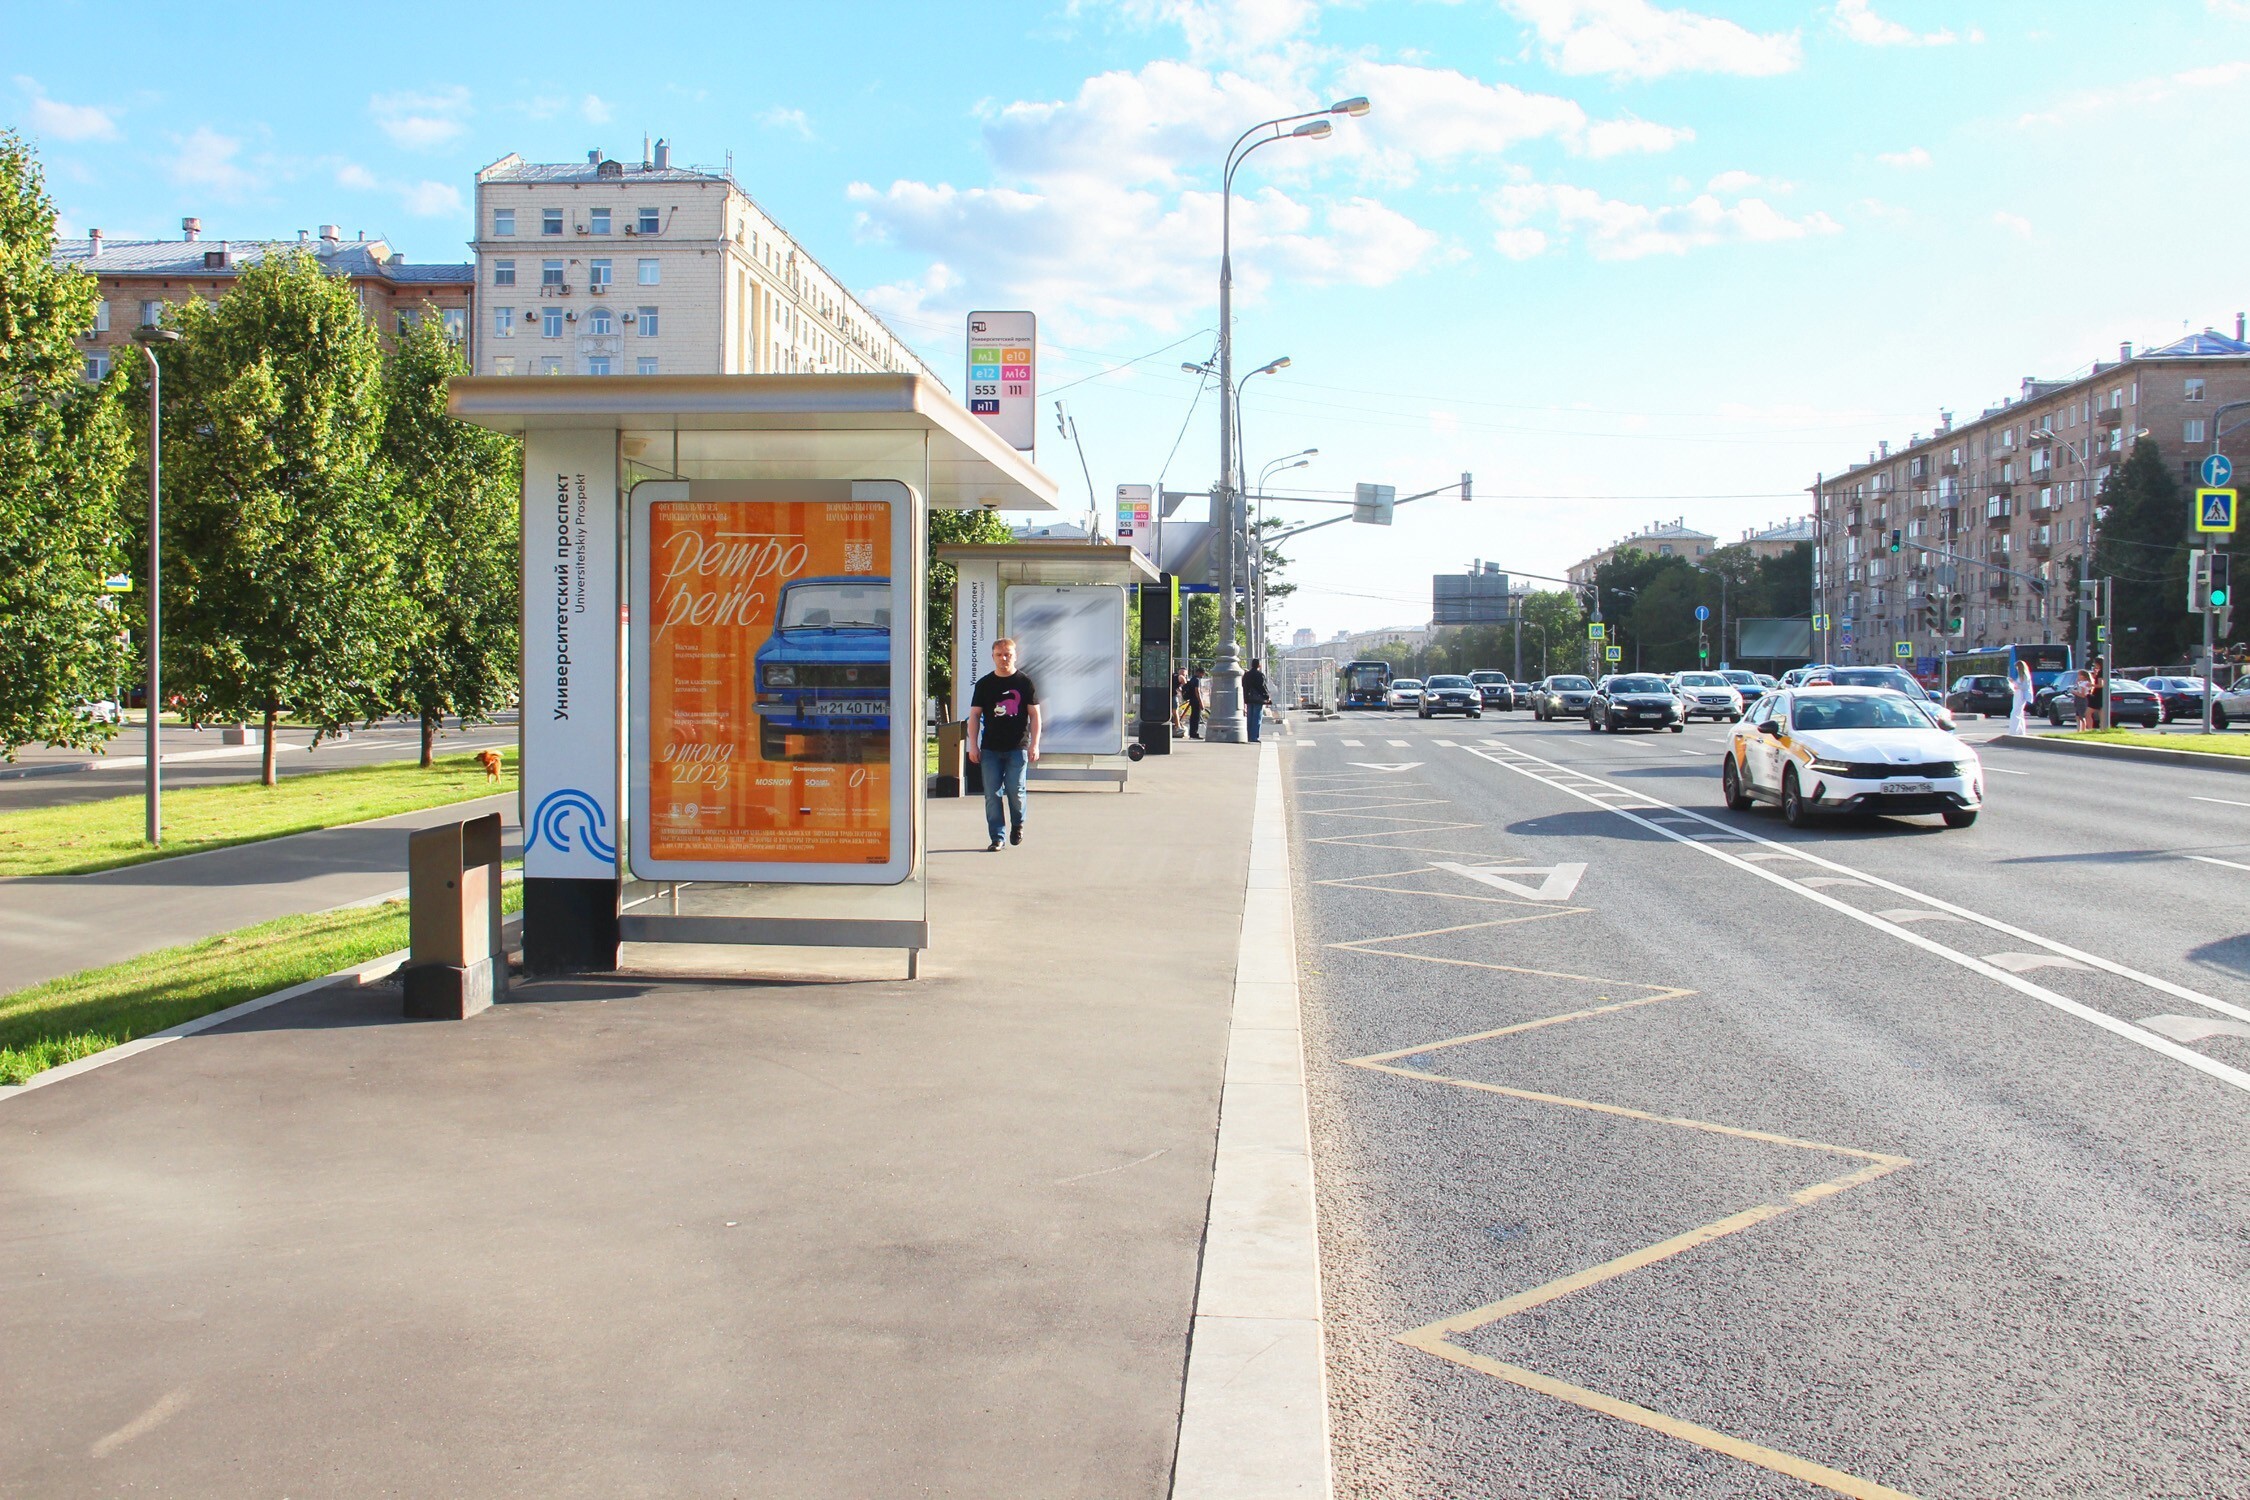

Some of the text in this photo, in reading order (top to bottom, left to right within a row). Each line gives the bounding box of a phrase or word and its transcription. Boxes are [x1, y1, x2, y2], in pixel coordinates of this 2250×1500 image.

[978, 352, 994, 361] м1
[1006, 352, 1026, 362] е10
[976, 368, 994, 378] е12
[1006, 368, 1026, 378] м16
[975, 385, 996, 395] 553
[1009, 386, 1022, 395] 111
[977, 402, 993, 411] н11
[575, 474, 588, 614] Universitetskiy Prospekt
[656, 530, 808, 603] Ретро
[554, 474, 572, 720] Университетский проспект
[970, 620, 979, 686] Университетский
[660, 743, 676, 762] 9
[672, 764, 729, 790] 2023
